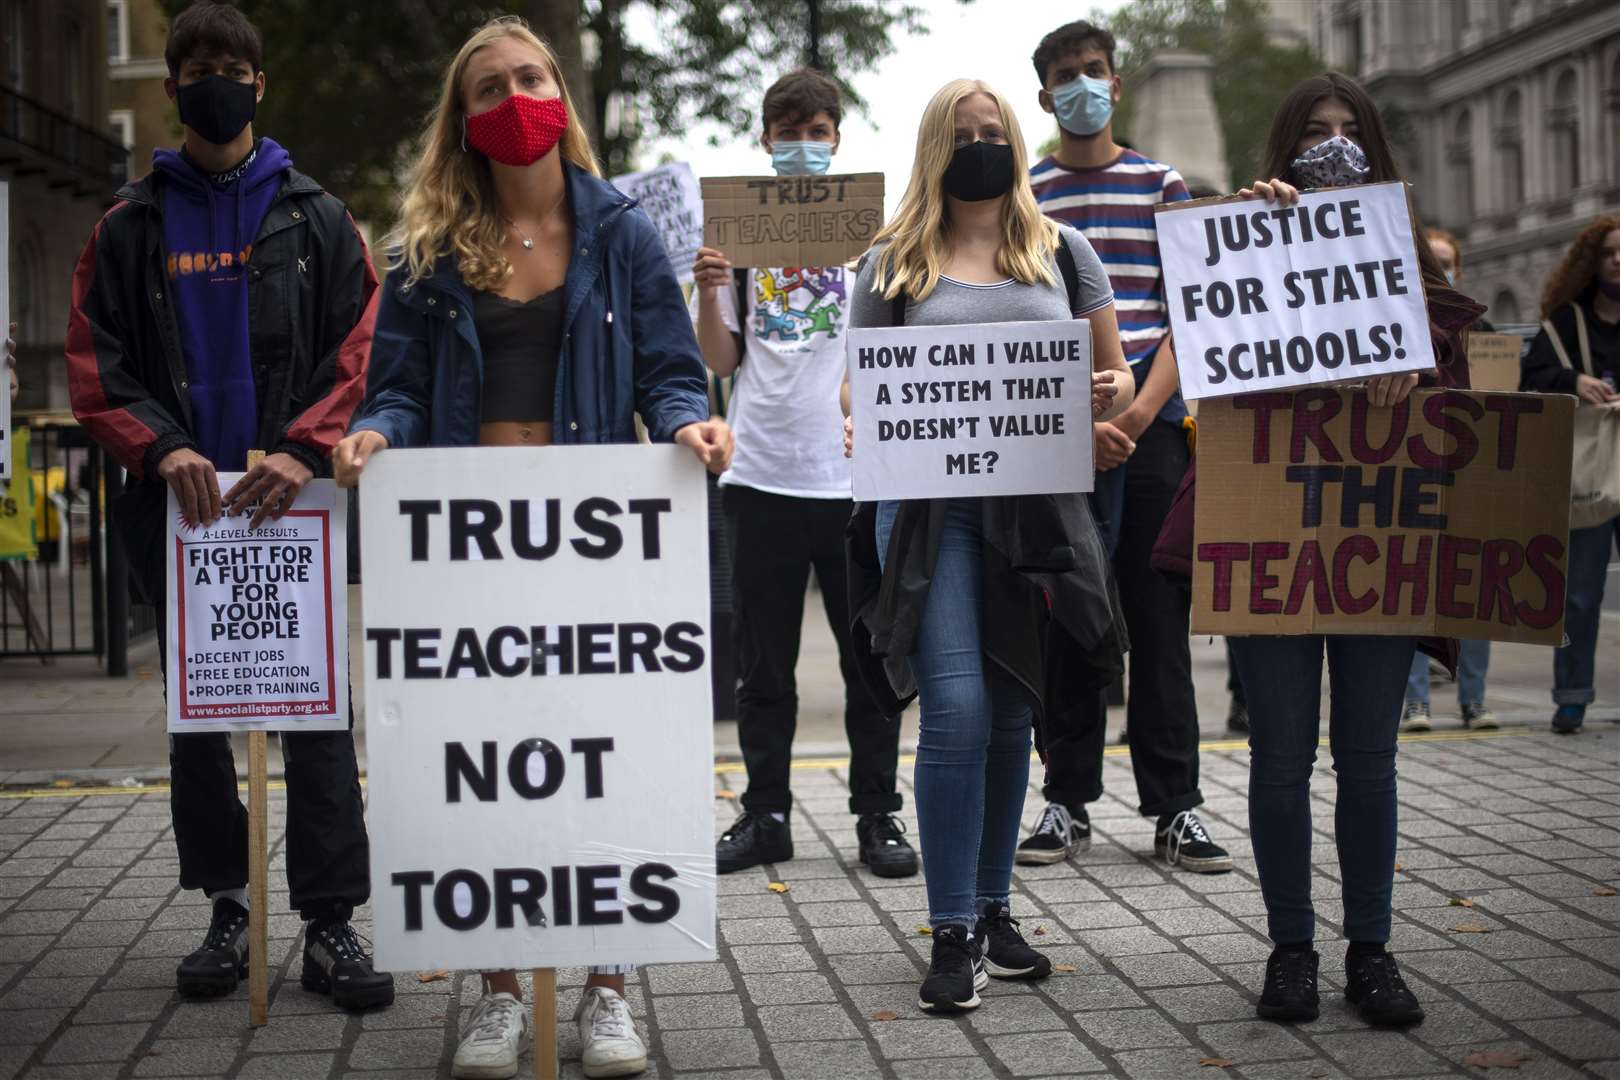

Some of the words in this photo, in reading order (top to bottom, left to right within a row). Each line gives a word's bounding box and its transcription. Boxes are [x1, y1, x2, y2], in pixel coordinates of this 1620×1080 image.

[747, 177, 855, 205] TRUST
[708, 209, 881, 245] TEACHERS
[1204, 199, 1366, 267] JUSTICE
[1180, 276, 1269, 322] FOR
[1286, 258, 1409, 310] STATE
[858, 346, 917, 369] HOW
[928, 344, 975, 366] CAN
[987, 343, 994, 364] I
[1003, 340, 1080, 364] VALUE
[1203, 323, 1407, 385] SCHOOLS!
[876, 383, 892, 405] A
[902, 380, 992, 404] SYSTEM
[1003, 377, 1065, 400] THAT
[878, 416, 980, 441] DOESN'T
[989, 414, 1065, 437] VALUE
[1233, 389, 1544, 470] TRUST
[946, 451, 999, 475] ME?
[1286, 465, 1456, 530] THE
[202, 529, 254, 540] A-LEVELS
[256, 528, 299, 538] RESULTS
[399, 497, 672, 561] TRUST
[190, 546, 263, 567] FIGHT
[270, 546, 313, 564] FOR
[195, 567, 212, 585] A
[219, 565, 309, 585] FUTURE
[1198, 534, 1566, 630] TEACHERS
[231, 583, 279, 602] FOR
[210, 602, 298, 622] YOUNG
[211, 621, 300, 641] PEOPLE
[195, 651, 251, 664] DECENT
[254, 650, 285, 664] JOBS
[366, 621, 706, 679] TEACHERS
[195, 669, 230, 680] FREE
[234, 666, 310, 679] EDUCATION
[196, 685, 252, 697] PROPER
[256, 682, 320, 695] TRAINING
[187, 702, 330, 717] www.socialistparty.org.uk
[444, 736, 614, 803] NOT
[391, 863, 681, 931] TORIES
